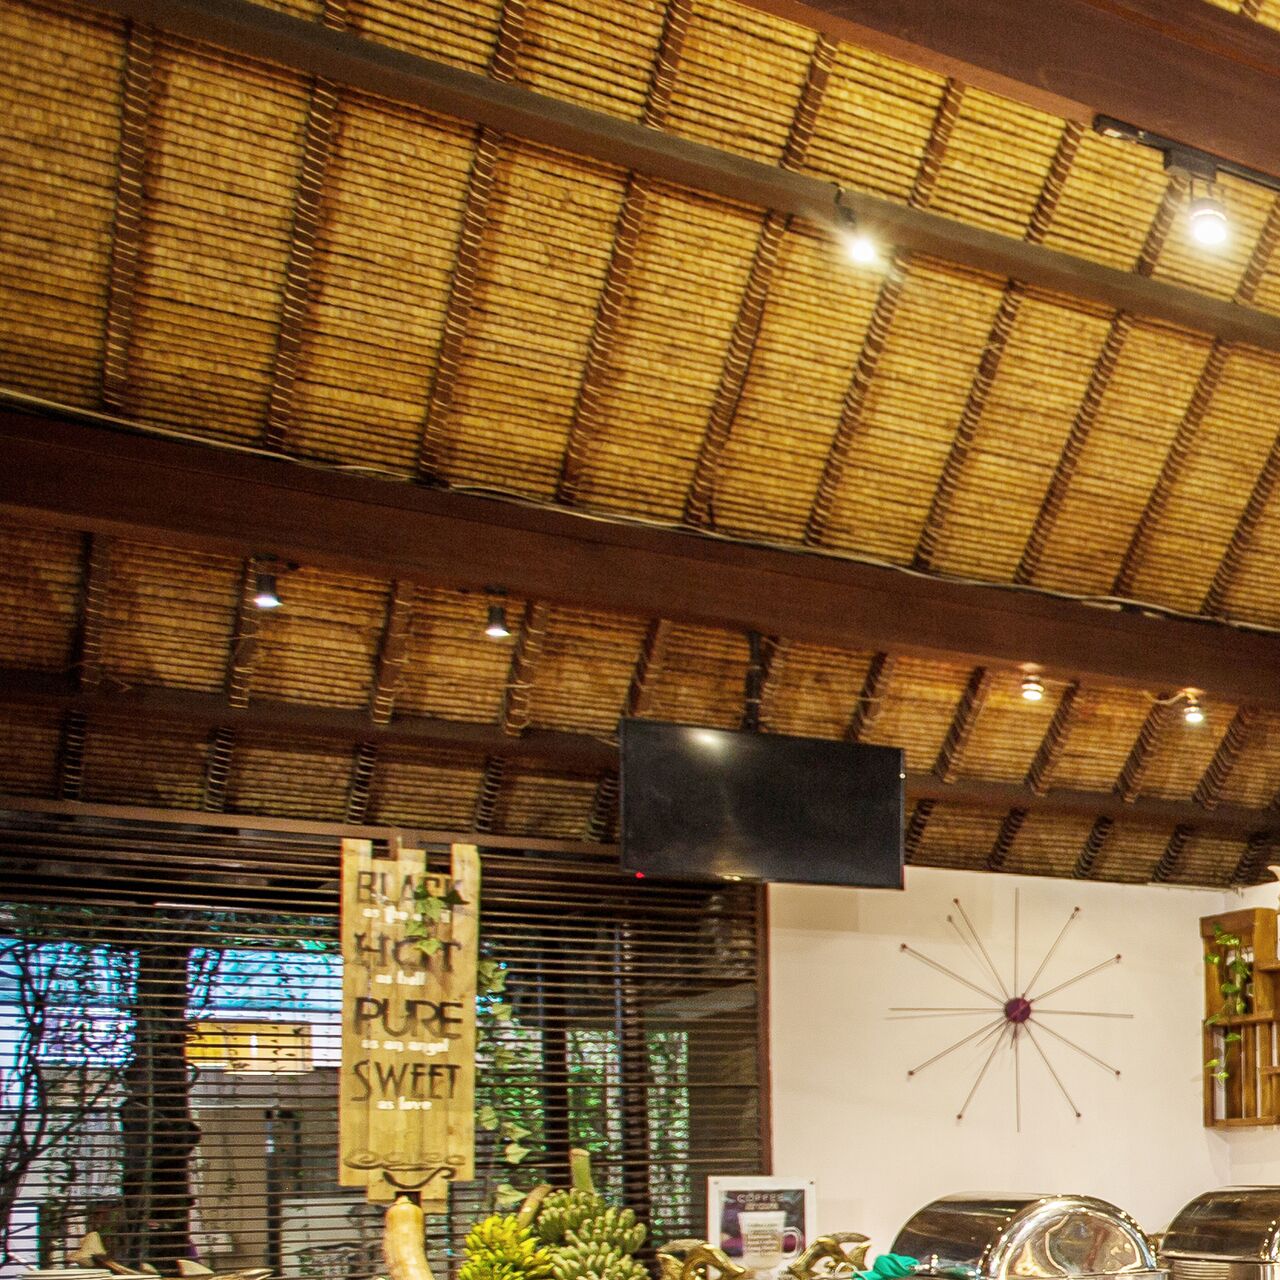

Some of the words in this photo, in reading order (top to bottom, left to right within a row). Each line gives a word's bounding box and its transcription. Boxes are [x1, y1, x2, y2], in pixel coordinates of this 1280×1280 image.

[354, 932, 462, 972] HOT
[353, 997, 464, 1039] PURE
[351, 1059, 462, 1102] SWEET
